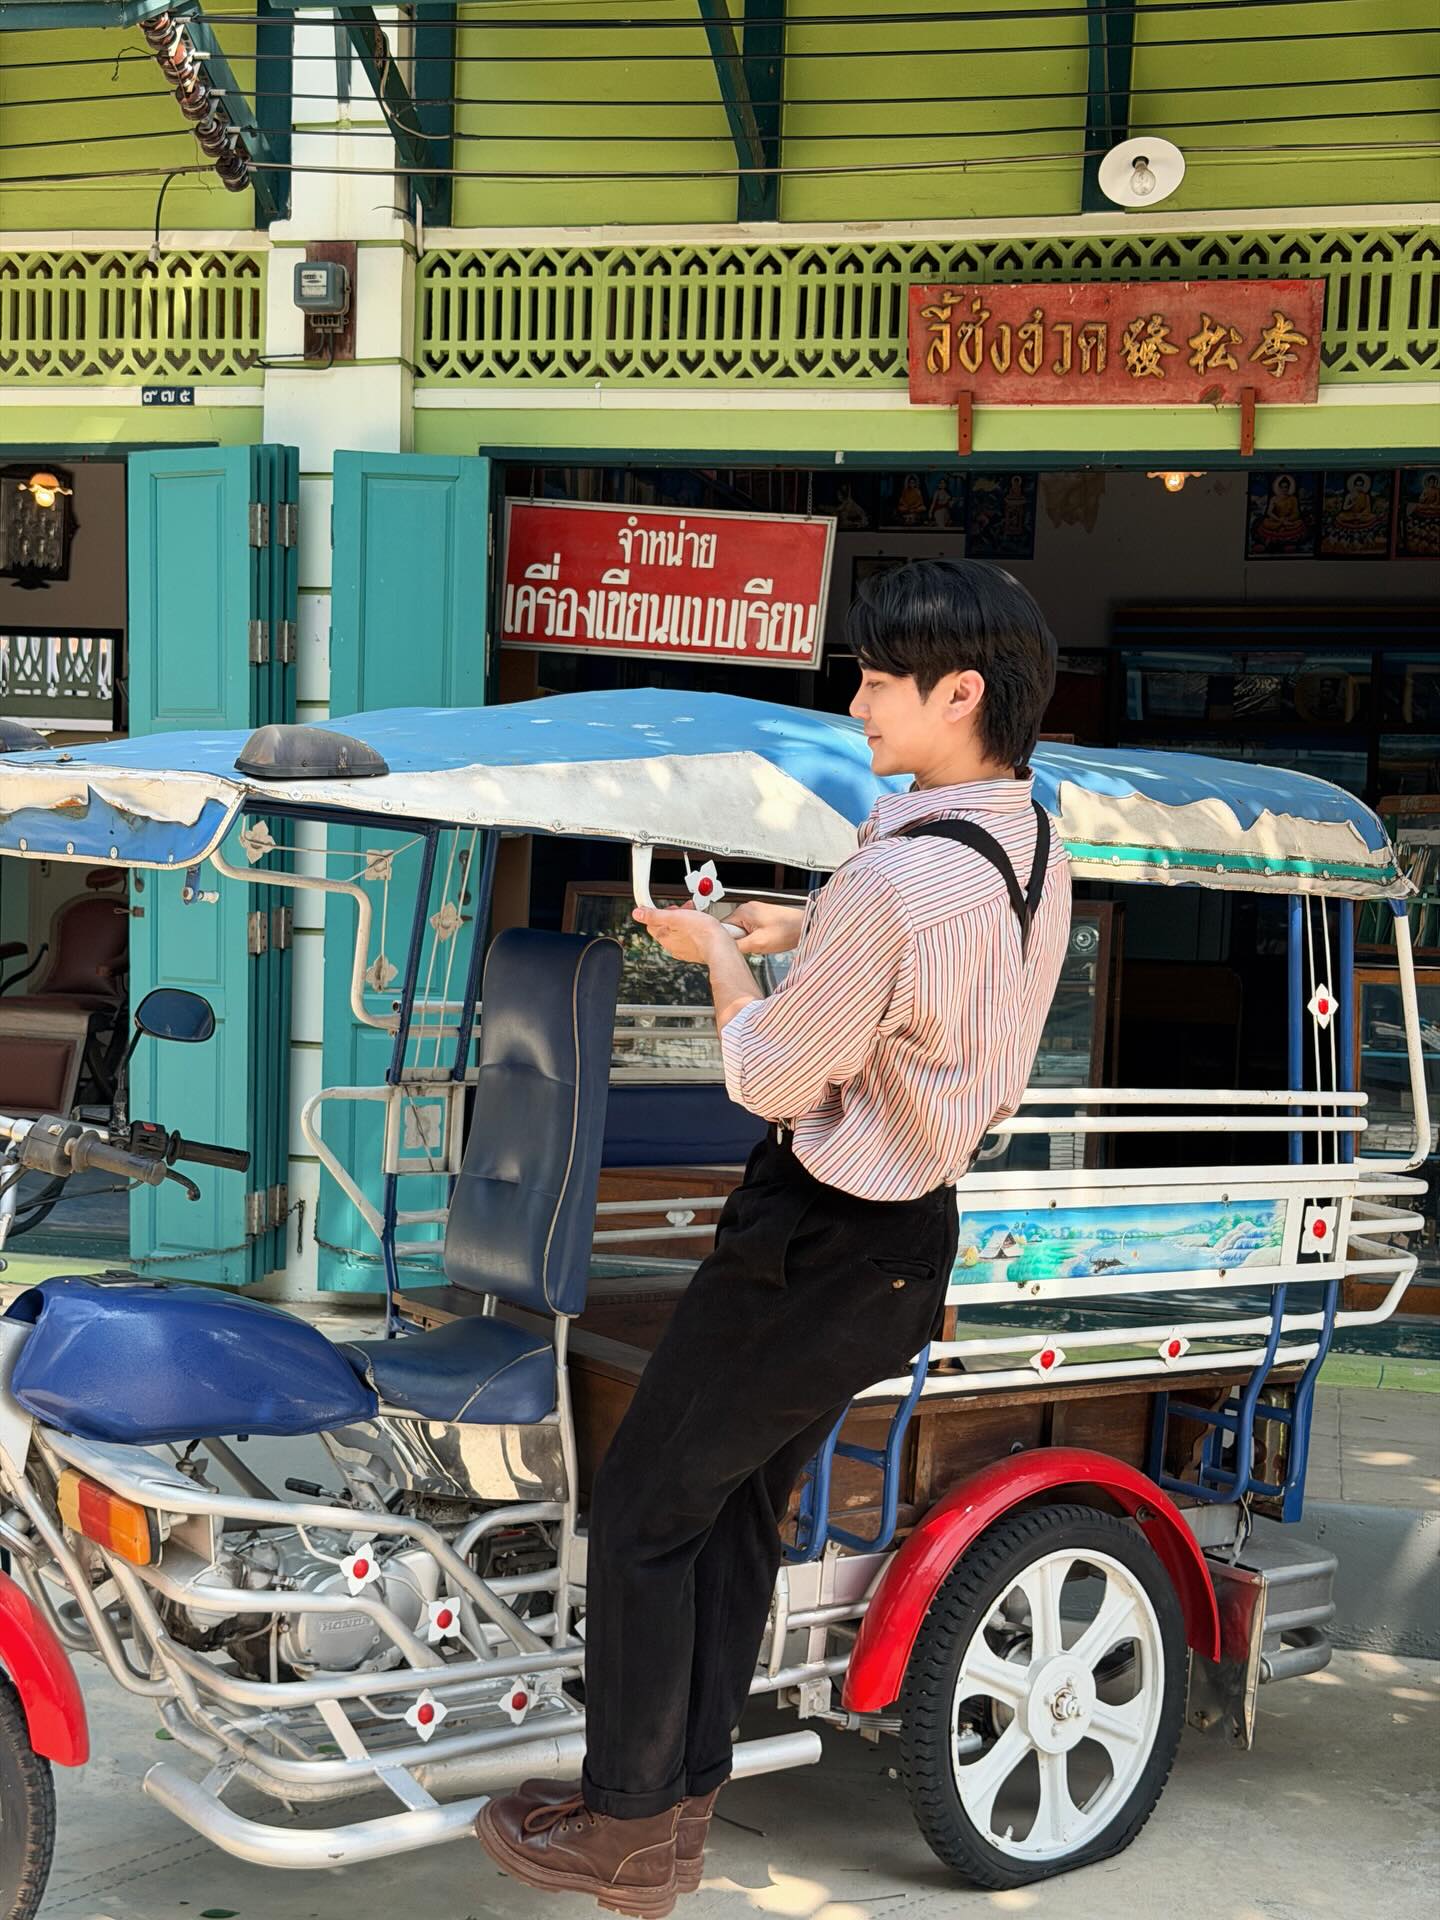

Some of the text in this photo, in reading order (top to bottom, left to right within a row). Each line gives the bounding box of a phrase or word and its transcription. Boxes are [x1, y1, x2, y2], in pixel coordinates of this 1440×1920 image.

[617, 516, 717, 569] จำหน่าย
[503, 552, 818, 654] เครื่องเขียนแบบเรียน
